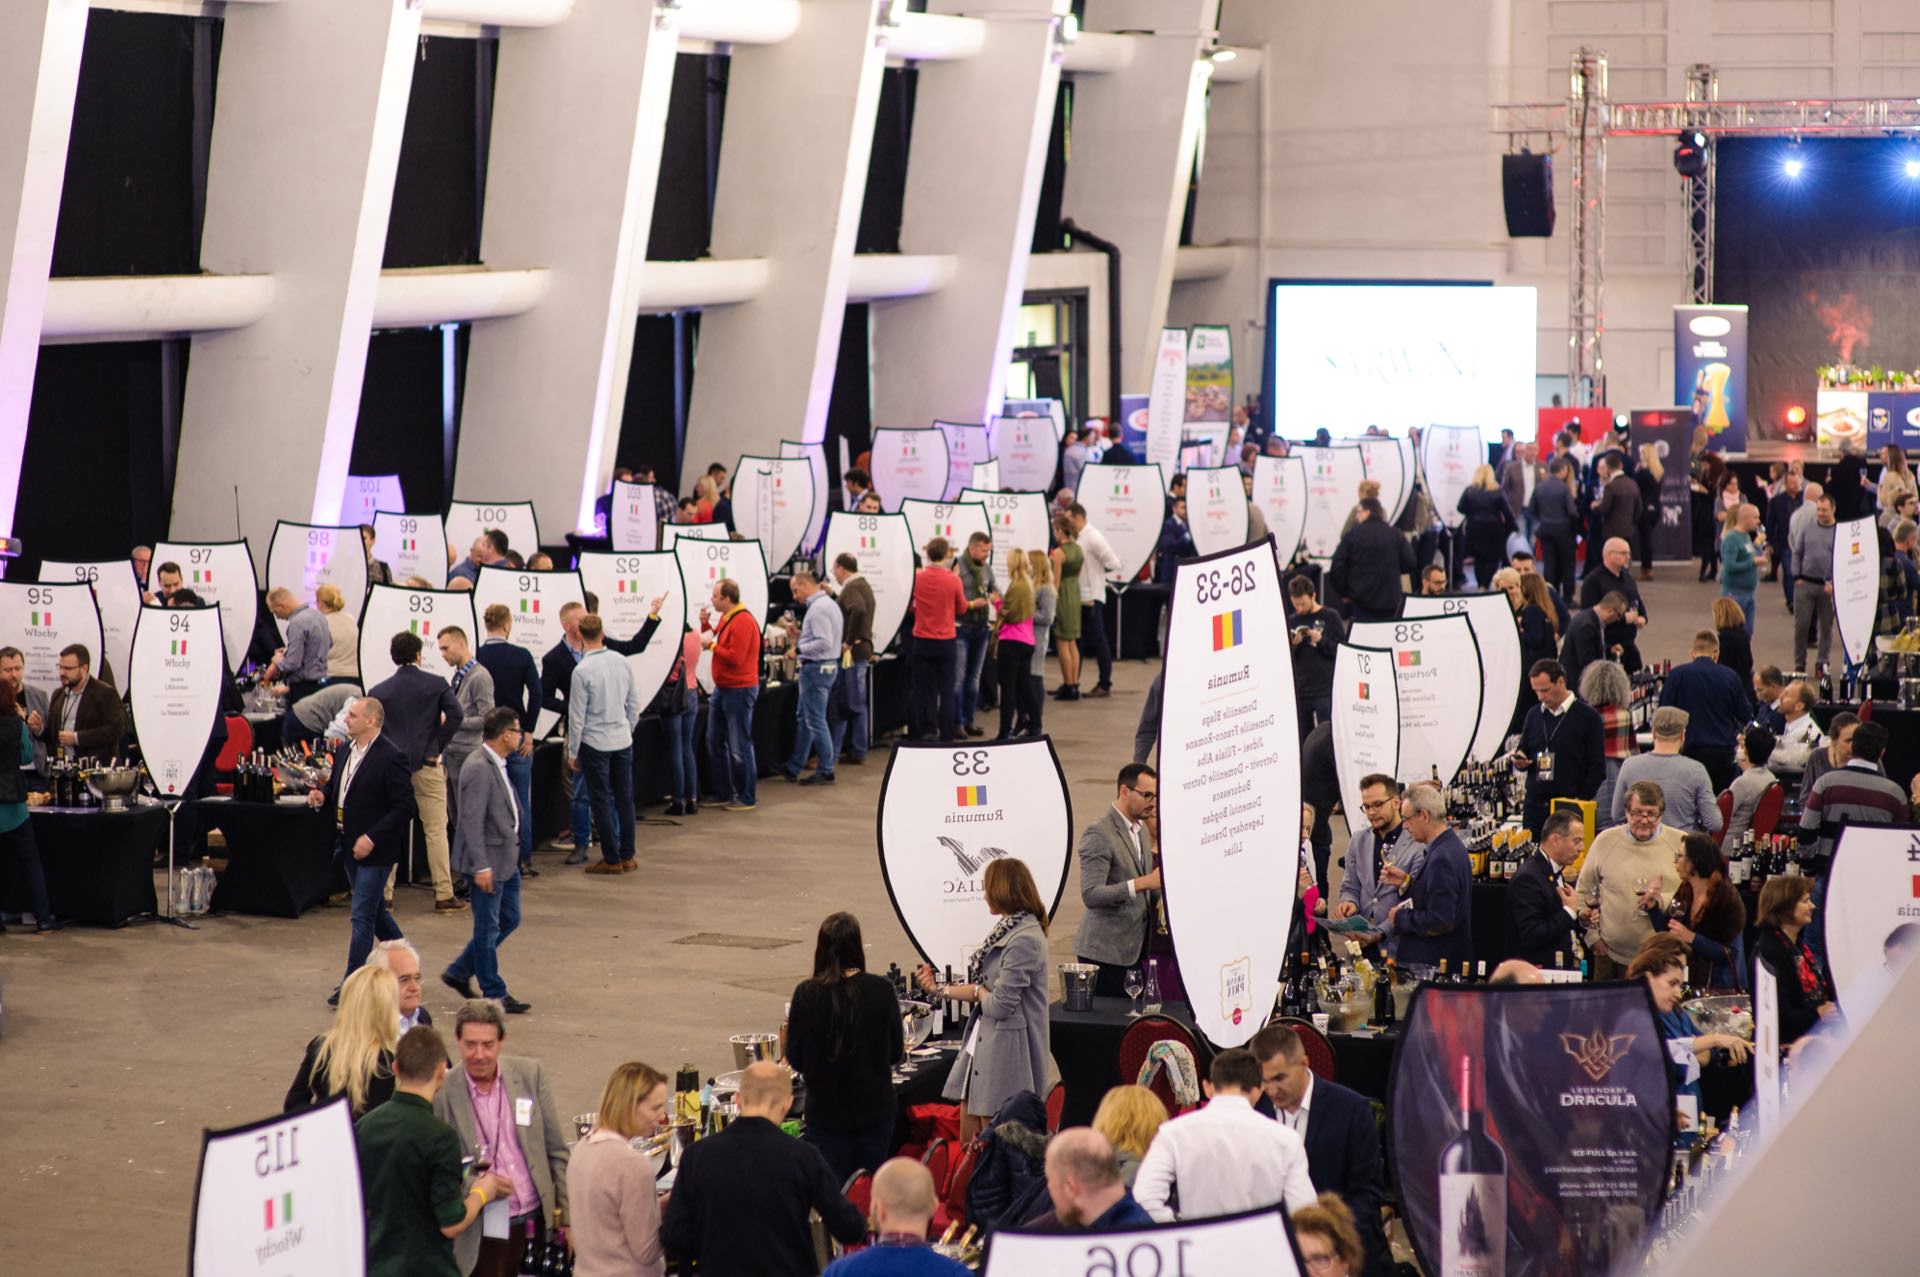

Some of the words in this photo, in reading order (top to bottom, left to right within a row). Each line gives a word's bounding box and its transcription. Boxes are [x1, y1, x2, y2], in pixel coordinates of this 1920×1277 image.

[1315, 450, 1335, 462] 80
[1114, 468, 1131, 481] 77
[988, 496, 1018, 510] 105
[475, 508, 507, 522] 100
[934, 506, 954, 519] 87
[400, 519, 418, 534] 99
[308, 531, 330, 546] 98
[190, 549, 212, 564] 97
[75, 566, 99, 582] 96
[518, 576, 541, 592] 91
[28, 588, 54, 604] 95
[409, 595, 434, 614] 93
[170, 614, 190, 632] 94
[24, 628, 58, 640] Włochy
[164, 658, 191, 668] Włochy
[1560, 1094, 1638, 1106] DRACULA
